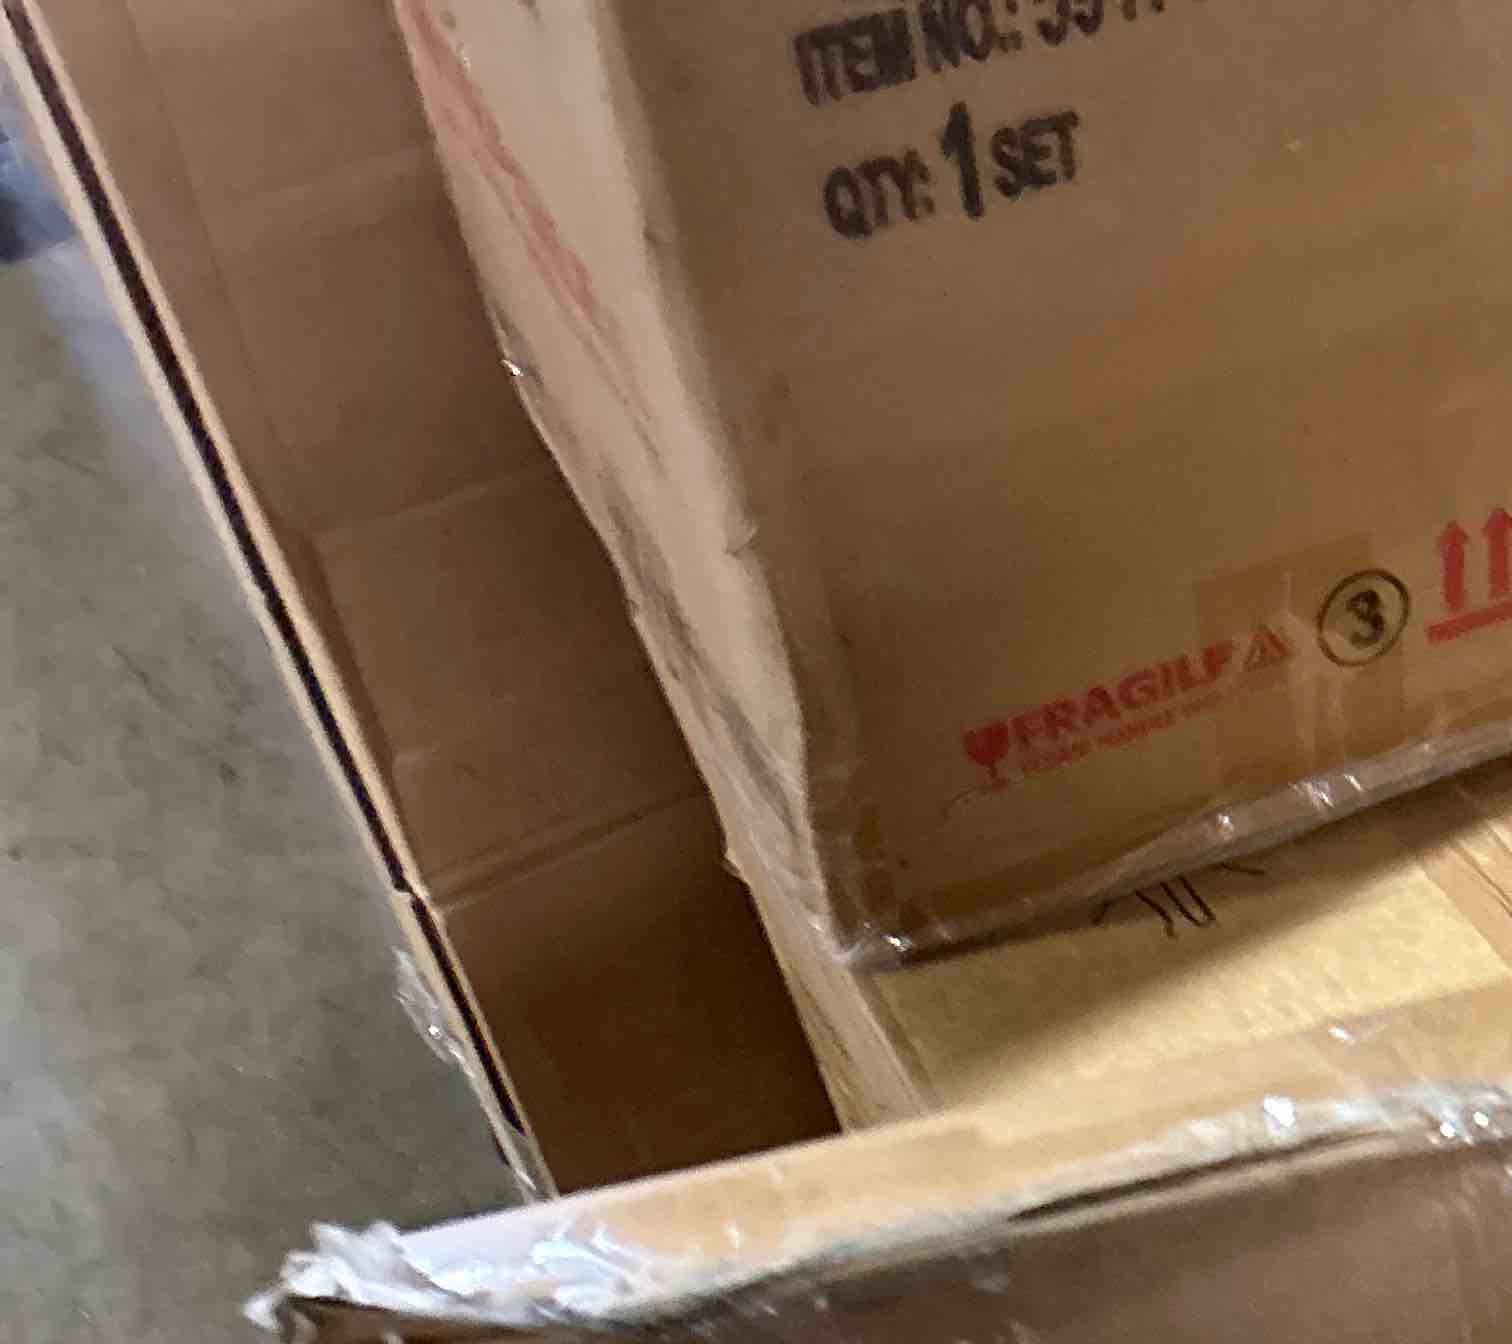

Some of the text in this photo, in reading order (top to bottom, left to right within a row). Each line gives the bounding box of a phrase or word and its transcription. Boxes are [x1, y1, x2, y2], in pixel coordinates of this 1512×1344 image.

[795, 9, 918, 104] ITEM
[941, 101, 985, 219] 1
[990, 110, 1081, 200] SET
